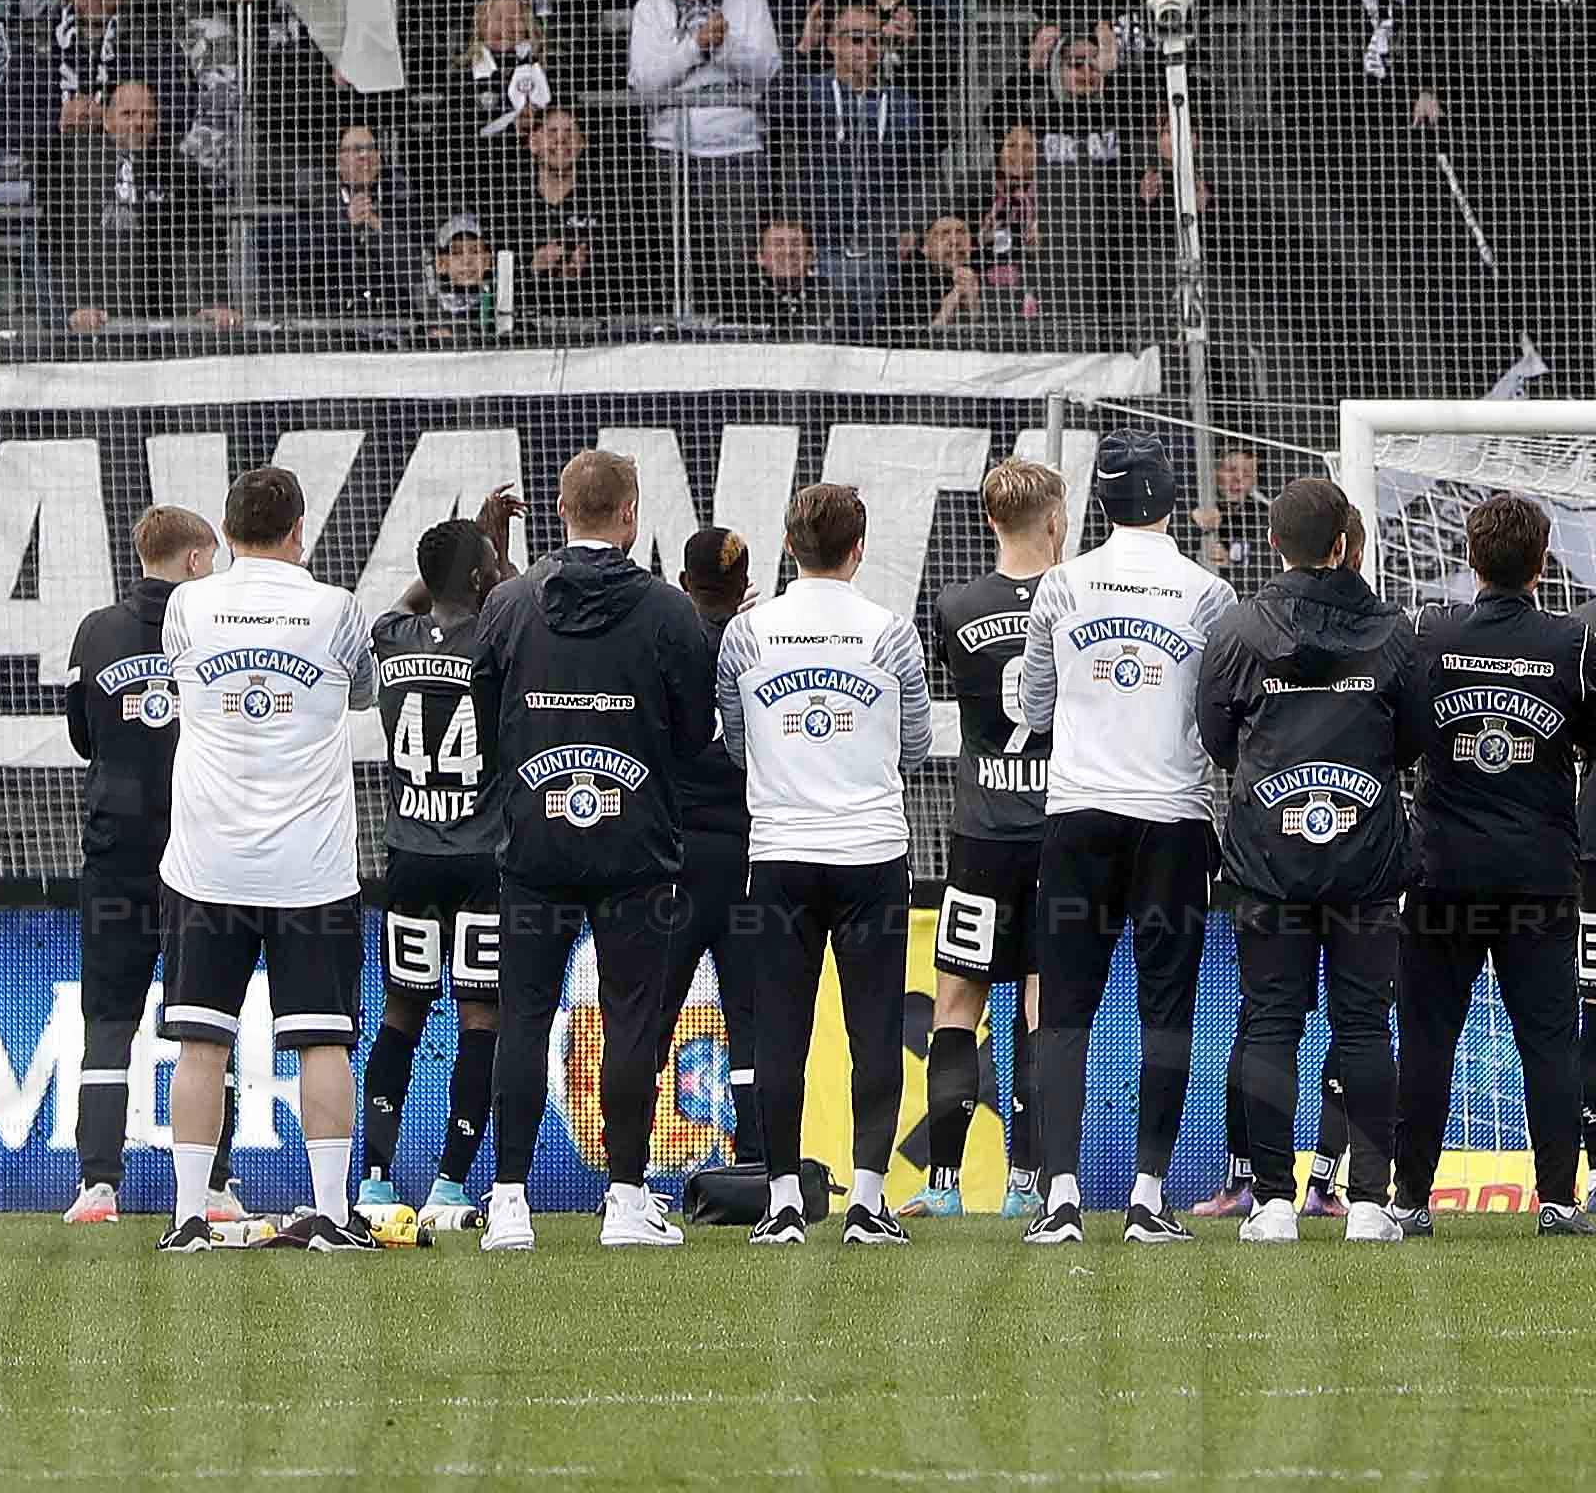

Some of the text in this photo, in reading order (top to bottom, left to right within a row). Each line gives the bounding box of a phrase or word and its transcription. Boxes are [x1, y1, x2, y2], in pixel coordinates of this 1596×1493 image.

[1073, 618, 1190, 664] PUNTIGAMER
[105, 655, 173, 689] PUNTIG
[199, 650, 320, 687] PUNTIGAMER
[758, 668, 878, 706] PUNTIGAMER
[1434, 689, 1559, 733] PUNTIGAMER
[393, 691, 484, 786] 44
[527, 748, 639, 786] PUNTIGAMER
[1262, 764, 1376, 803] PUNTIGAMER
[398, 785, 478, 821] DANTE
